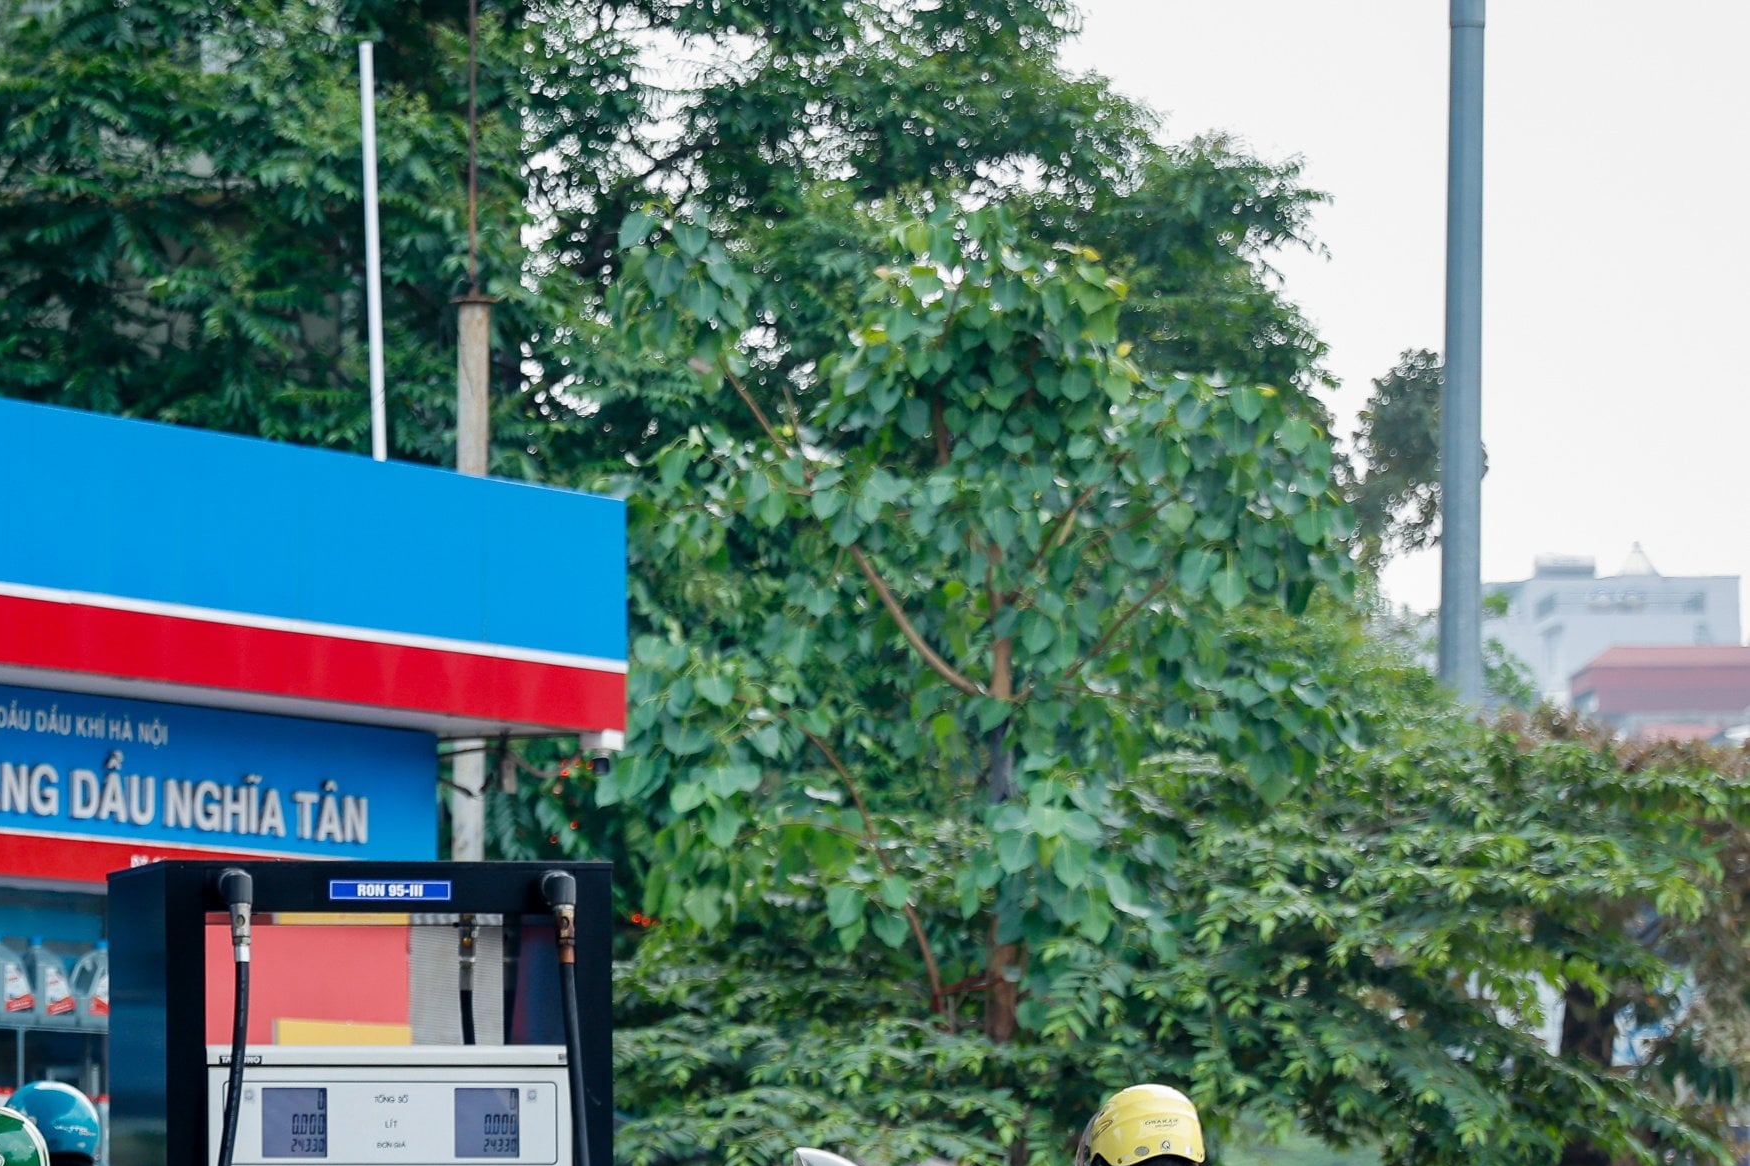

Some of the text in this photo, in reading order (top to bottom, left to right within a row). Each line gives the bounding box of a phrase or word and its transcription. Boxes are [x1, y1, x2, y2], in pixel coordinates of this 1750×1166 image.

[76, 712, 105, 740] KHÍ
[109, 714, 133, 742] HÀ
[138, 718, 168, 750] NỘI
[71, 750, 155, 826] DẦU
[164, 774, 286, 838] NGHĨA
[294, 779, 369, 844] TÂN
[357, 884, 423, 897] RON 95-III
[385, 1119, 398, 1128] LÍT
